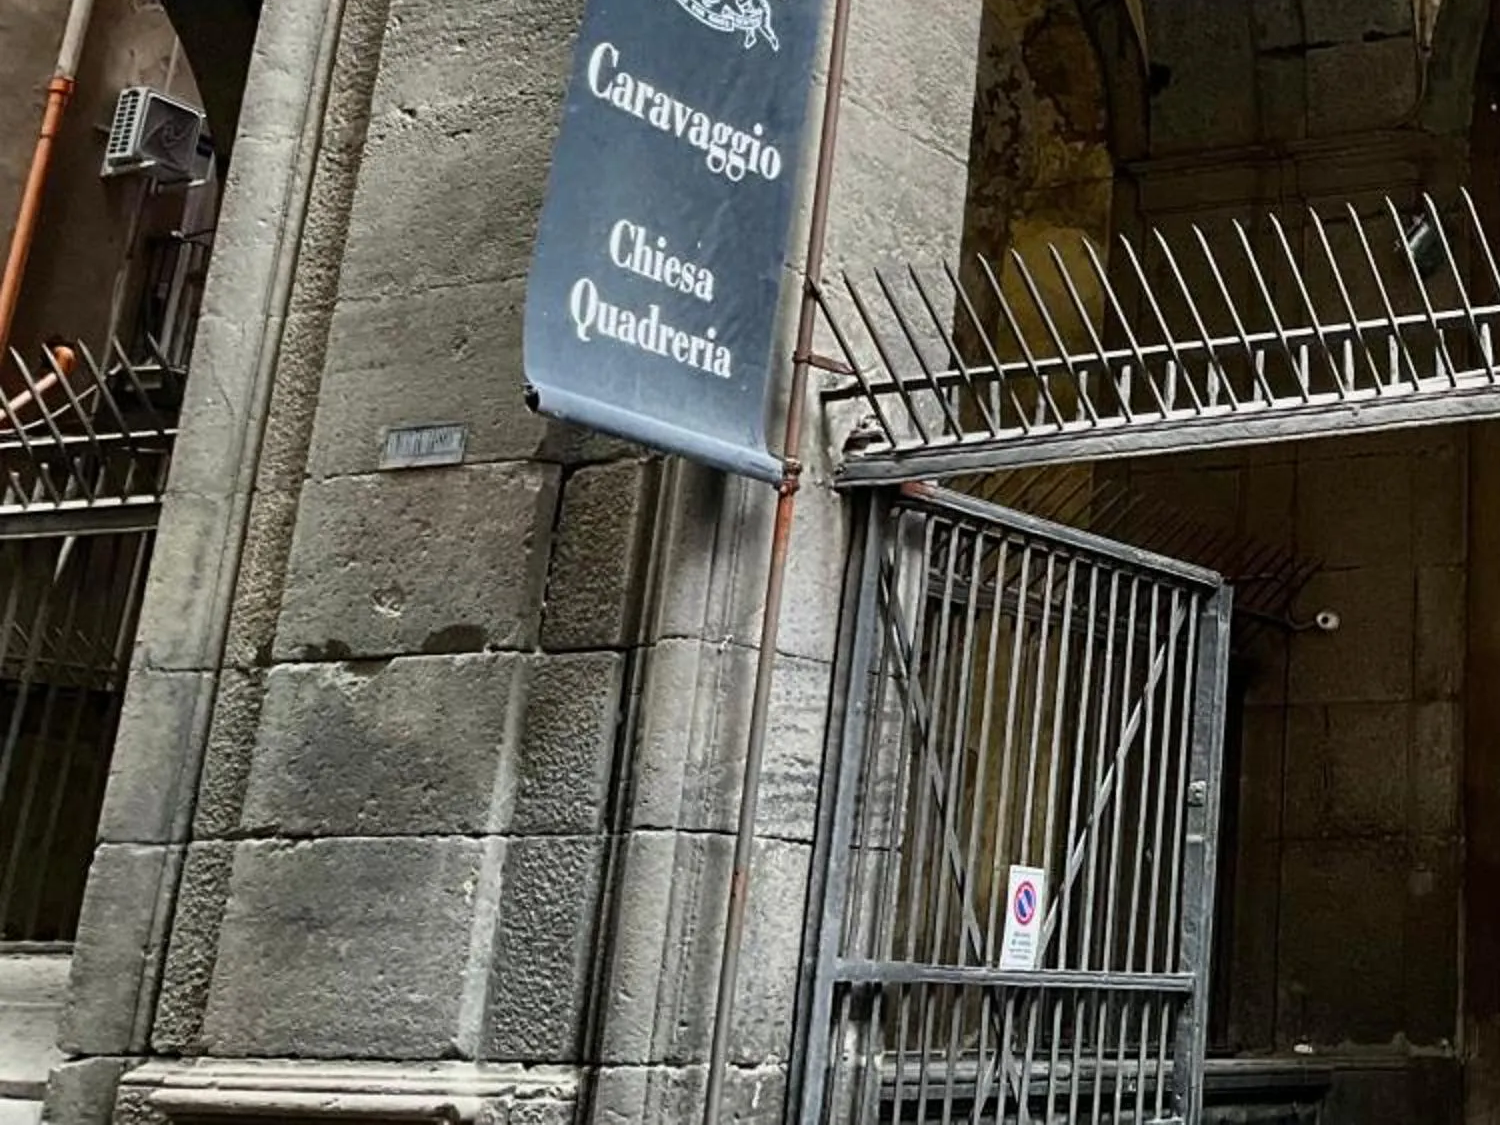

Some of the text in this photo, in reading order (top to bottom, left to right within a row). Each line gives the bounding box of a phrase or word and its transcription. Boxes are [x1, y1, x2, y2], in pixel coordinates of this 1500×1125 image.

[586, 41, 782, 182] Caravaggio
[608, 218, 715, 303] Chiesa
[569, 277, 733, 380] Quadreria
